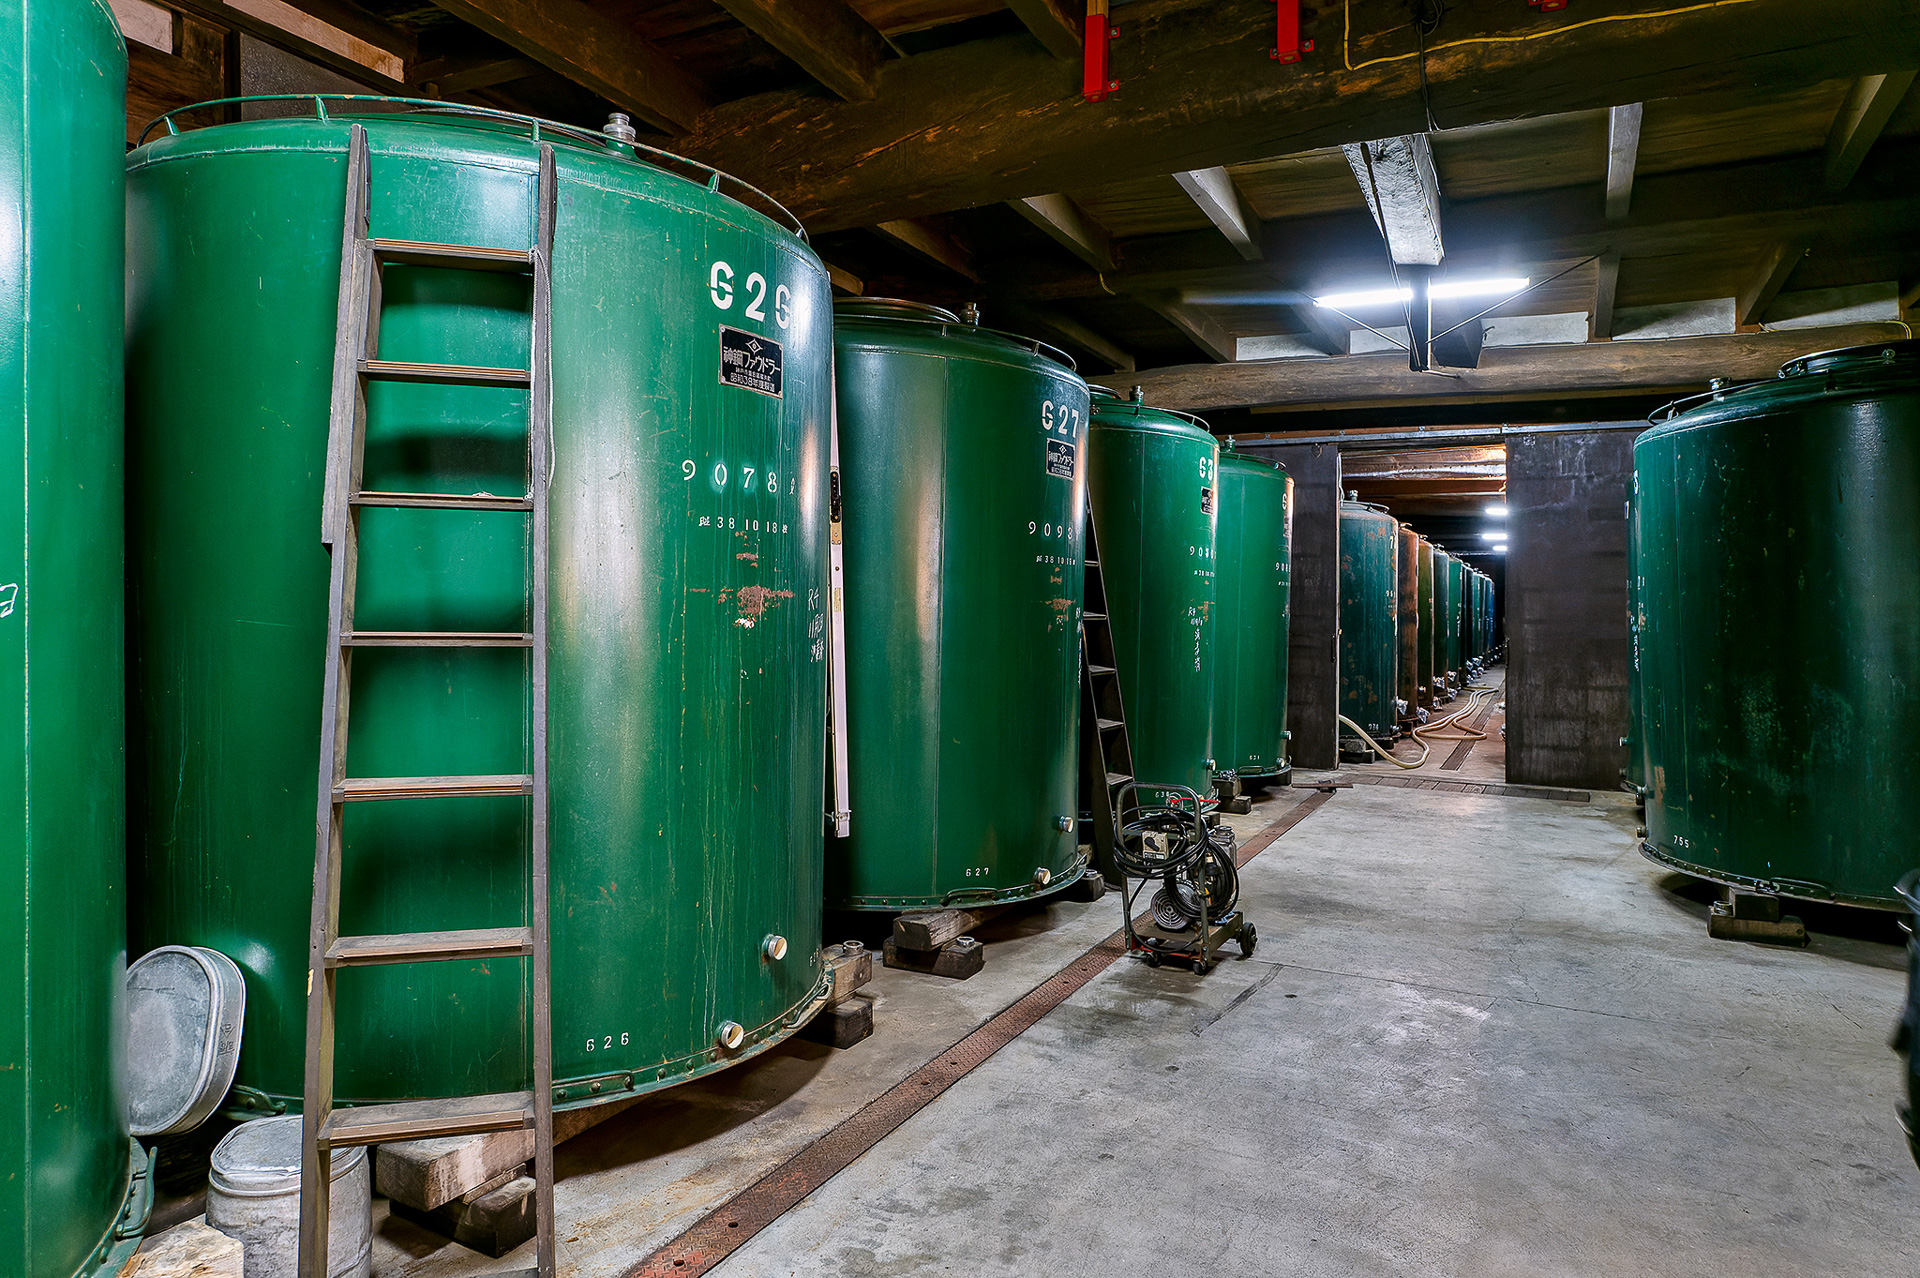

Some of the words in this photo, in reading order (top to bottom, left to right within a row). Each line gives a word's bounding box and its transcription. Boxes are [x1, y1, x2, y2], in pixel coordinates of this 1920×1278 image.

[681, 459, 777, 493] 9078
[965, 867, 989, 877] 627
[586, 1031, 630, 1052] 626
